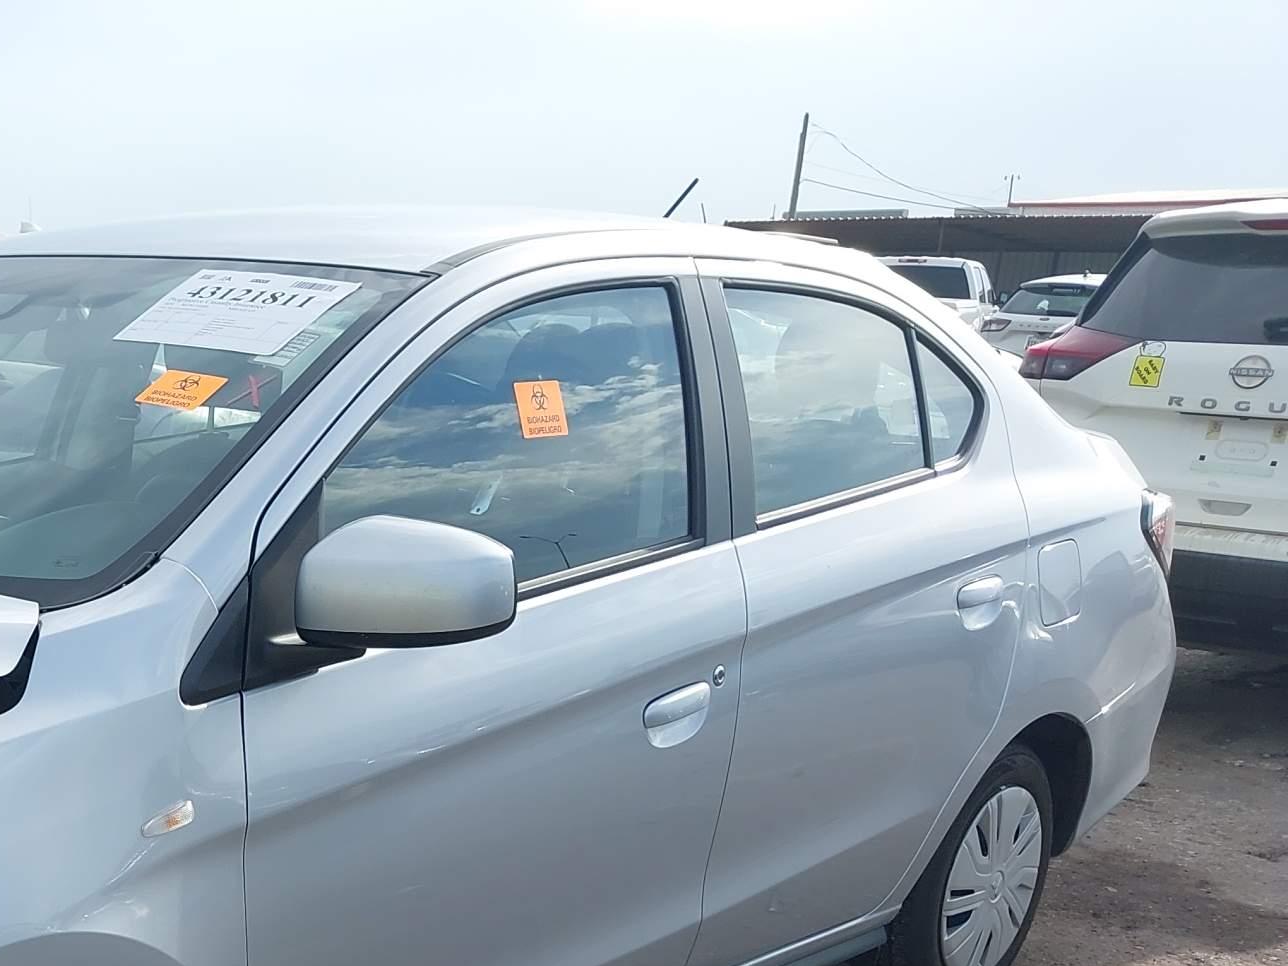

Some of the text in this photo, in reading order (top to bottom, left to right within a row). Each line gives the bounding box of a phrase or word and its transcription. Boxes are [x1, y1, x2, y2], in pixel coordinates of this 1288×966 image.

[187, 285, 316, 308] 43121811
[1143, 366, 1152, 375] ON
[1148, 360, 1159, 374] BABY
[1230, 368, 1273, 377] NISSAN
[1135, 366, 1149, 384] BOARD
[152, 389, 198, 402] BIOHAZARD
[526, 415, 560, 424] BIOHAZARD
